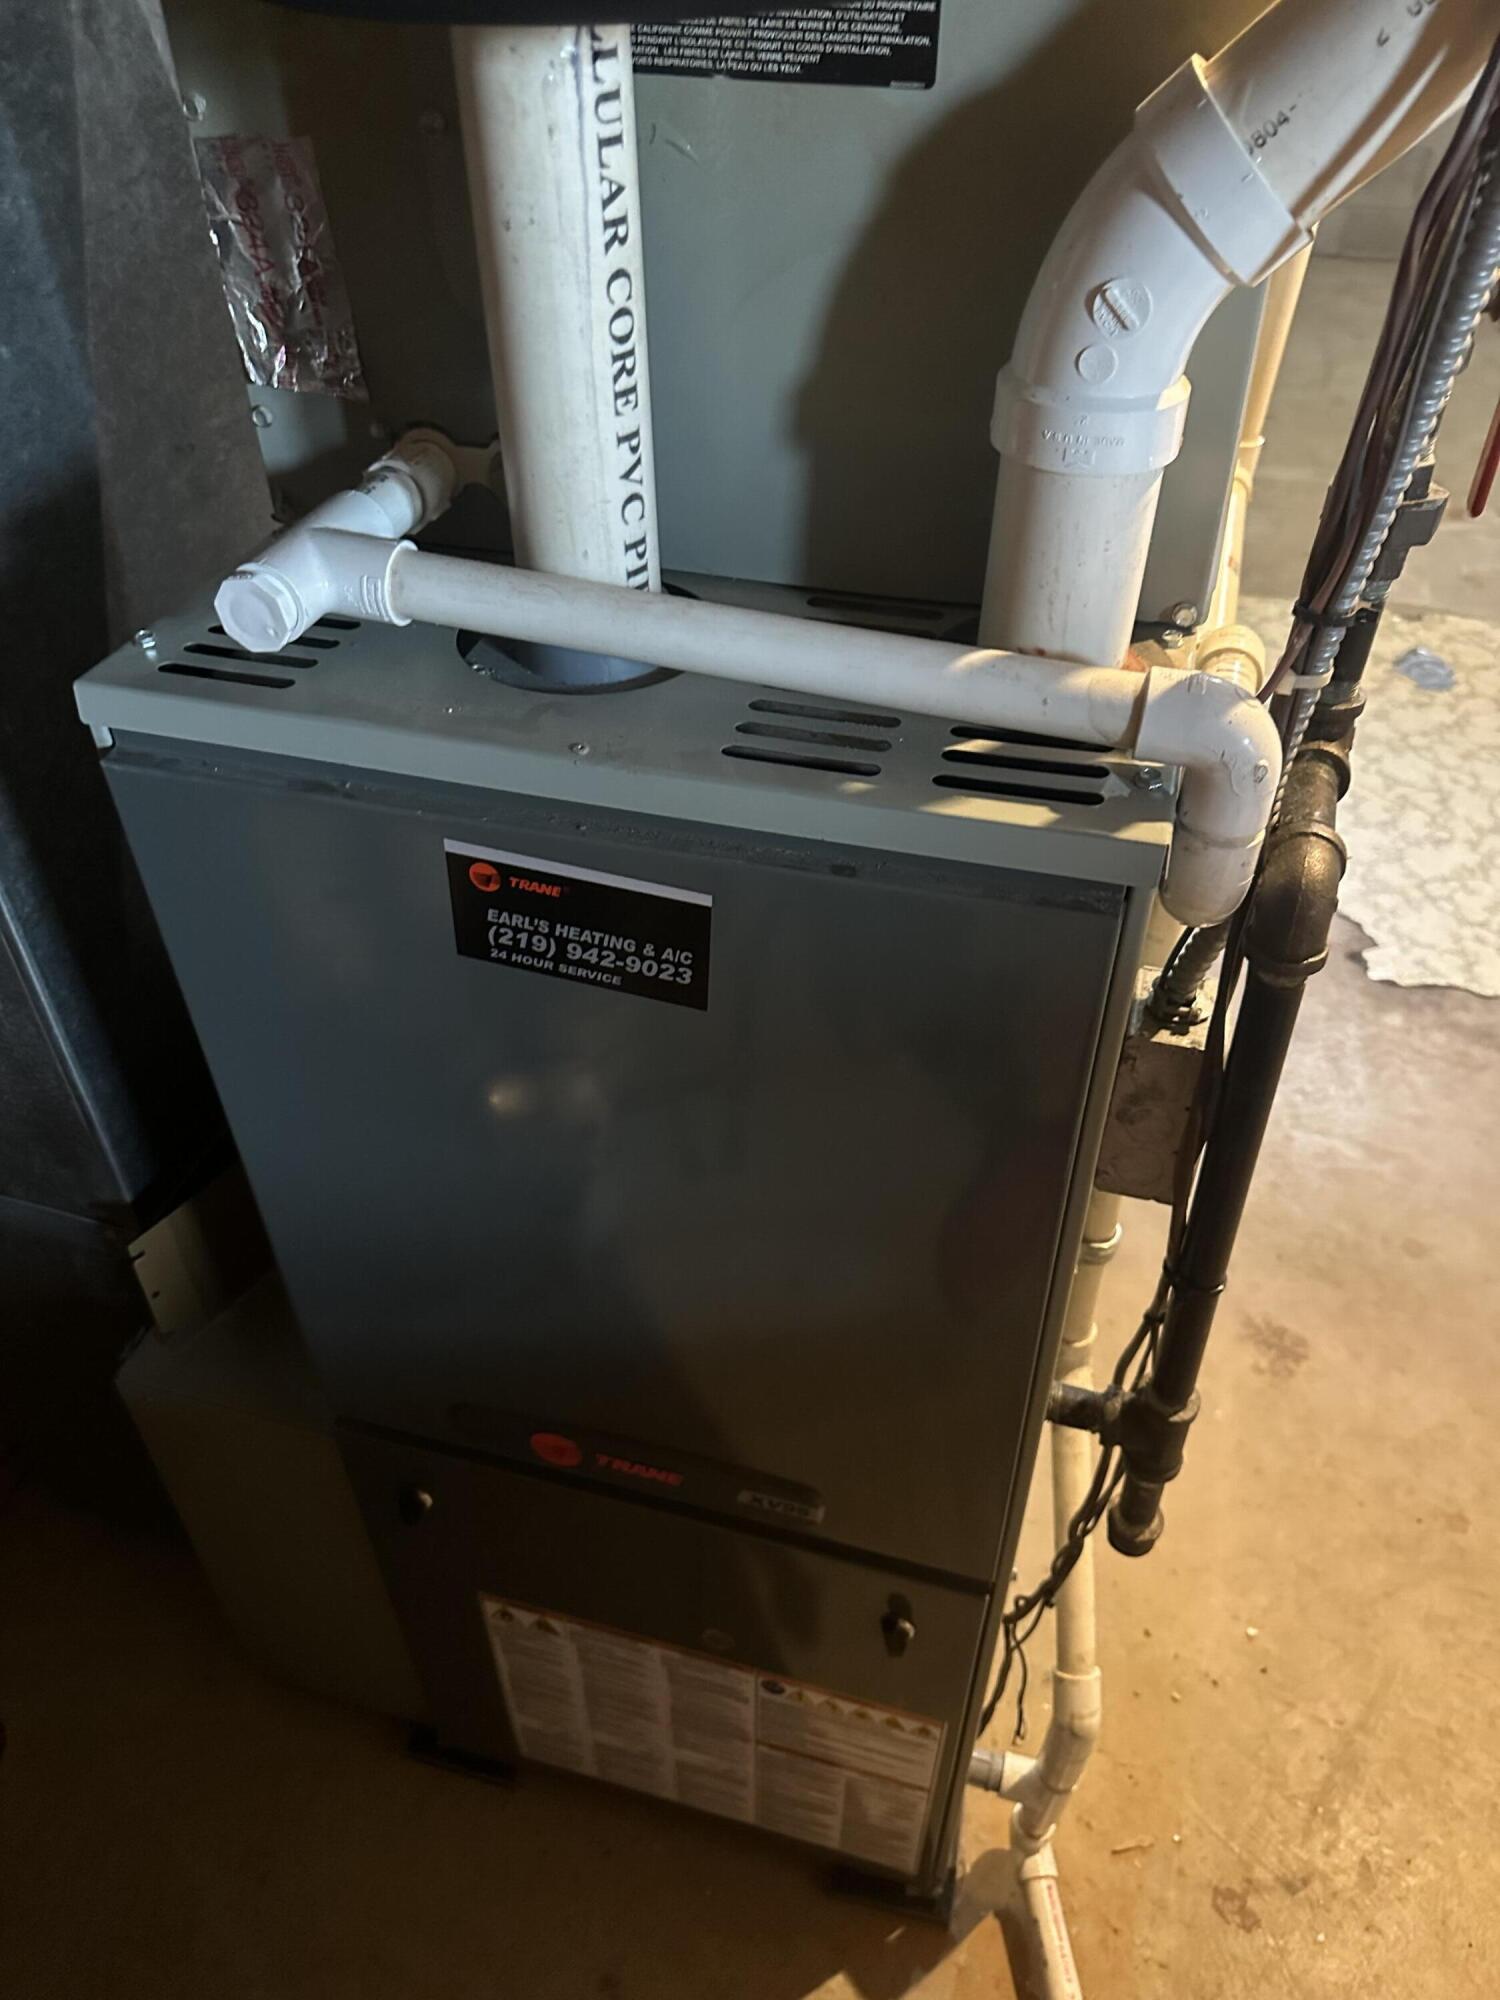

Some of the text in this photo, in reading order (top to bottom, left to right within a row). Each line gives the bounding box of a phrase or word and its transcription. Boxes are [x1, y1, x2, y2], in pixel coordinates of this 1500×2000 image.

[606, 268, 639, 417] CORE
[616, 428, 645, 526] PVC
[509, 876, 561, 897] TRANE
[487, 908, 693, 965] EARL'S HEATING & A/C
[487, 924, 693, 986] (219) 942-9023
[490, 948, 623, 987] 24 HOUR SERVICE
